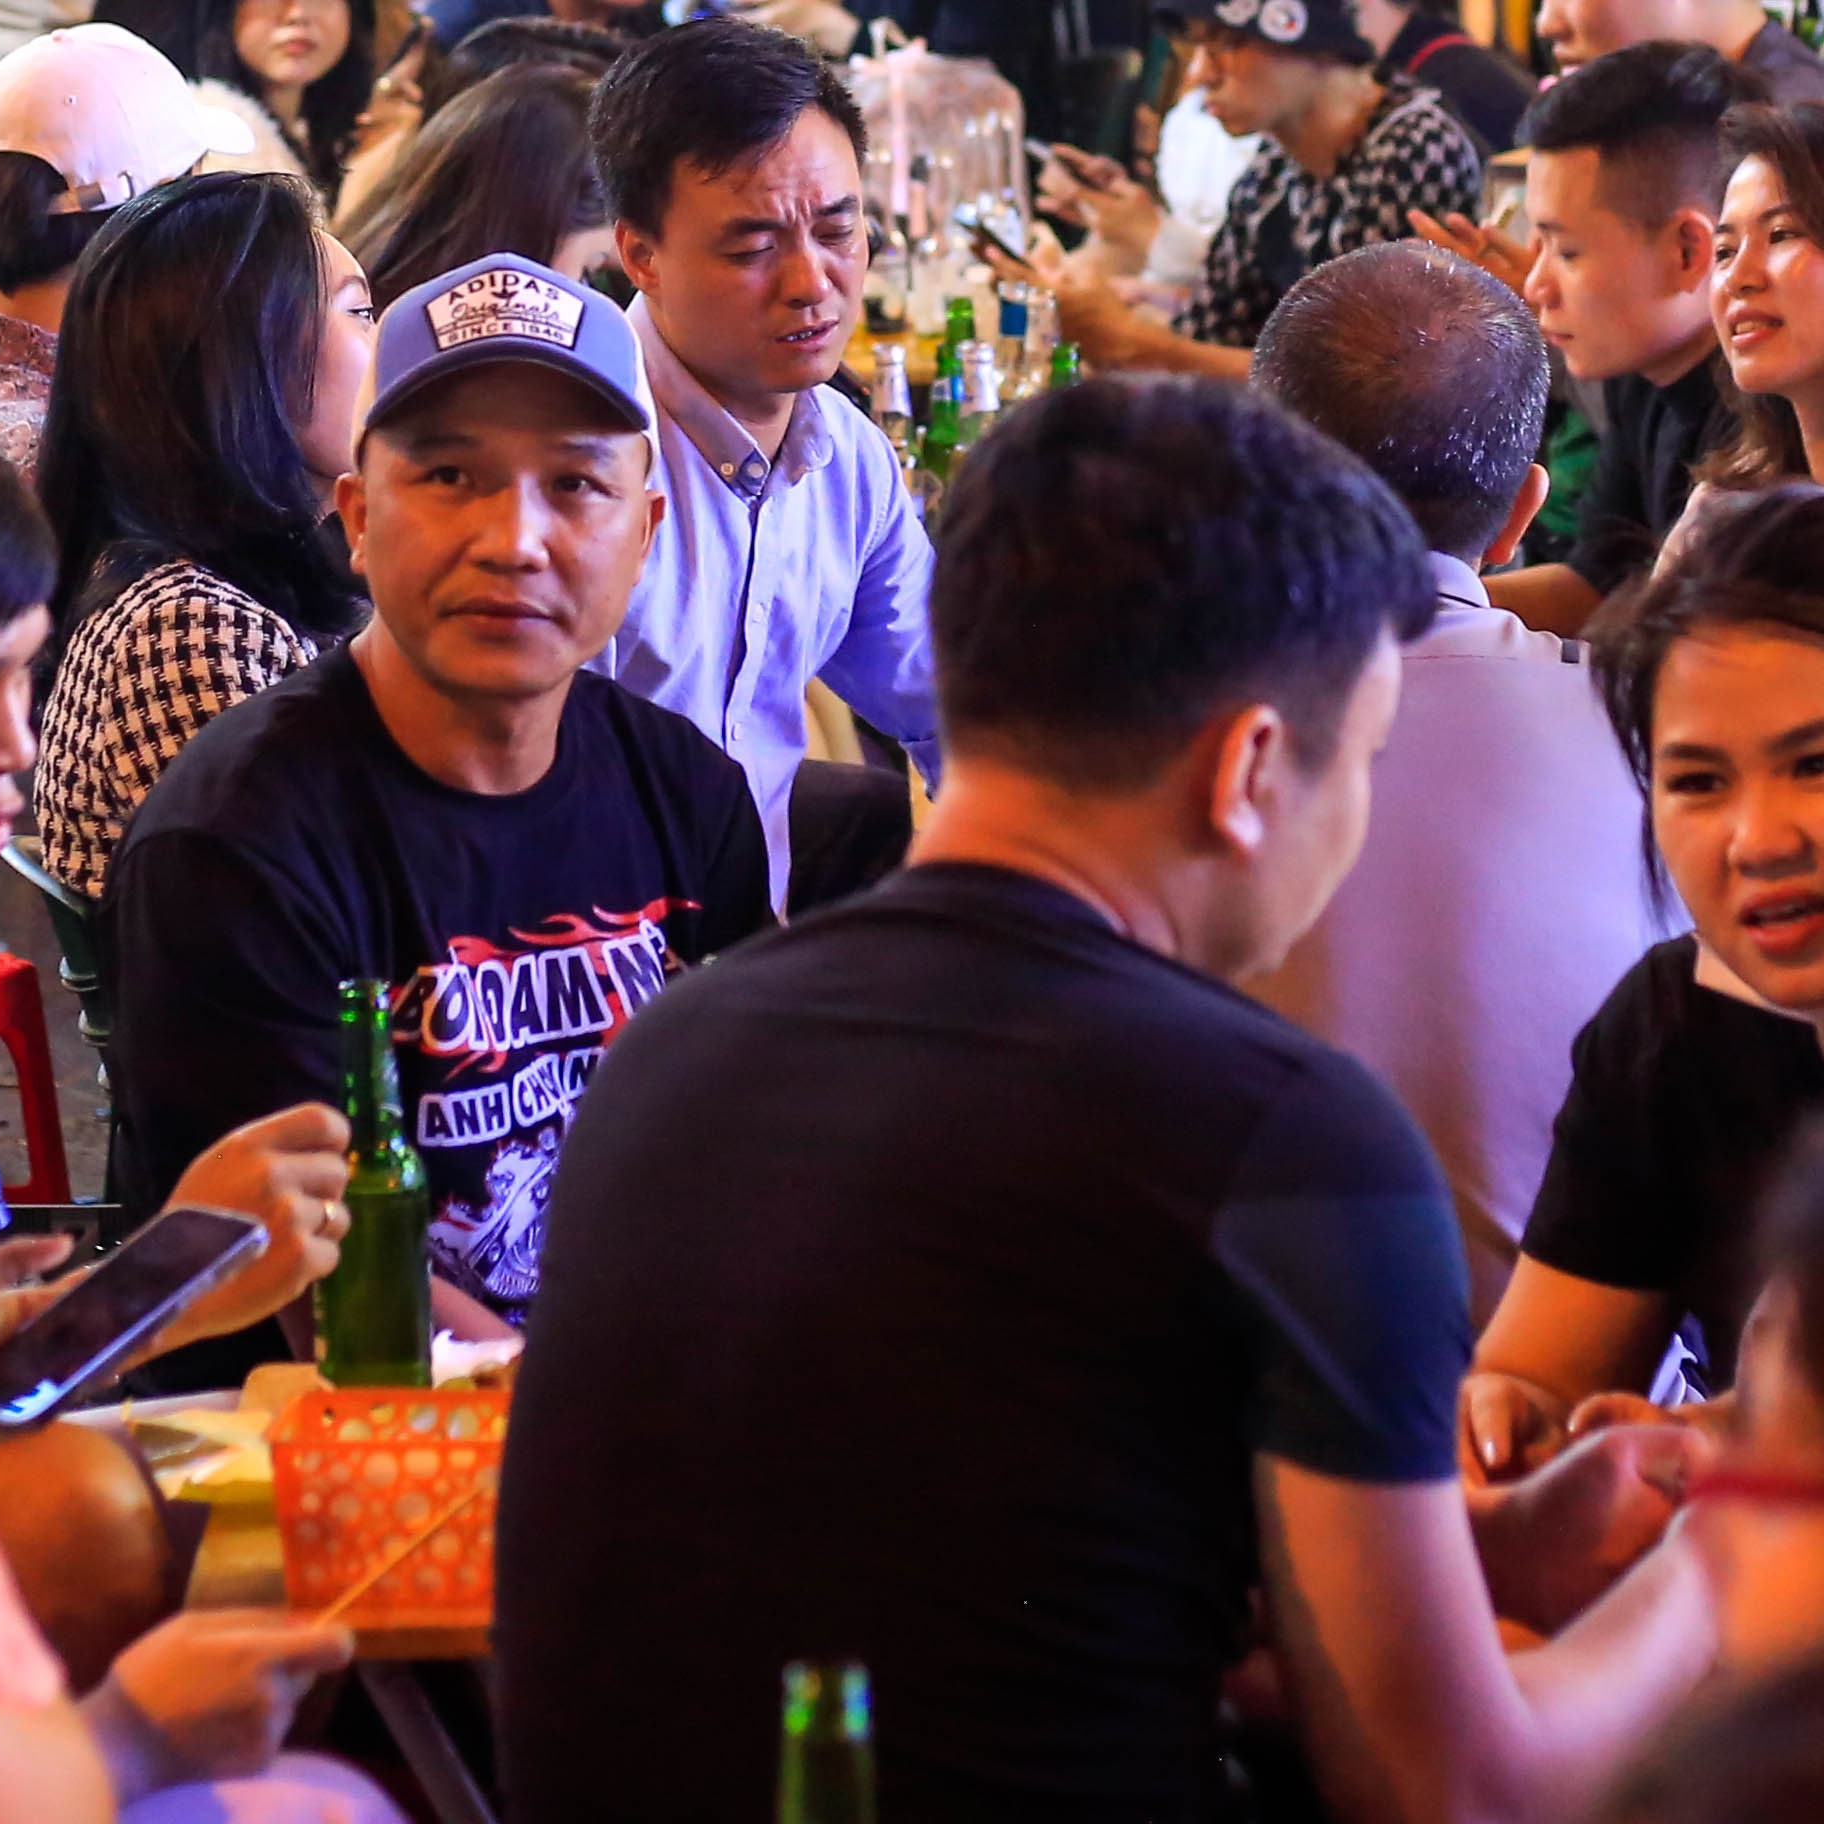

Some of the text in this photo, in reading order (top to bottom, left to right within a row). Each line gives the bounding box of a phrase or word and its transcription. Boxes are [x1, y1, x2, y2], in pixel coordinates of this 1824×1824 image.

[448, 273, 560, 306] ADIDAS
[448, 323, 511, 343] SINCE
[417, 1082, 512, 1147] ANH
